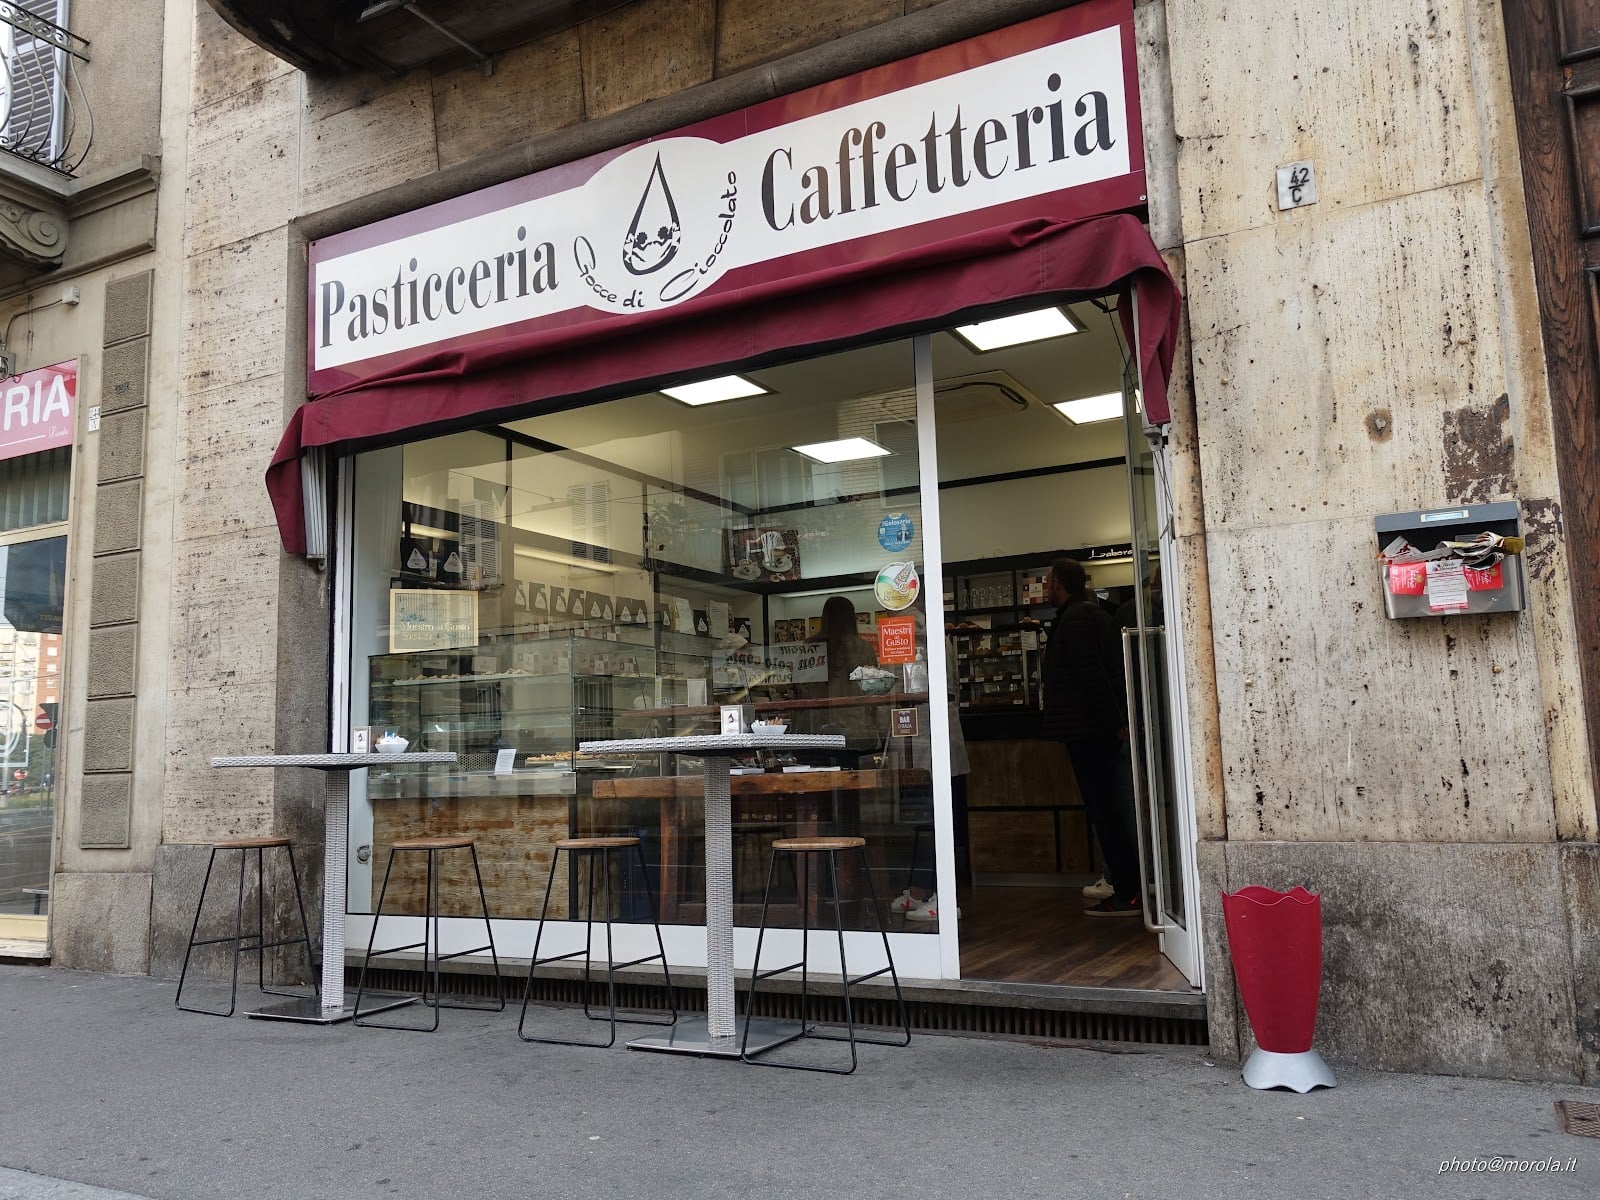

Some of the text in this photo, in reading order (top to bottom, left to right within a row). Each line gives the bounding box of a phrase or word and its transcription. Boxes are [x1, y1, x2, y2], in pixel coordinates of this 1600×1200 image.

[760, 72, 1116, 231] Caffetteria
[1290, 167, 1310, 186] 42
[1291, 187, 1302, 203] C
[574, 170, 737, 308] Gocce di Cioccolato
[318, 226, 559, 348] Pasticceria
[0, 374, 70, 432] RIA
[883, 626, 911, 636] Maestri
[885, 638, 908, 647] Gusto
